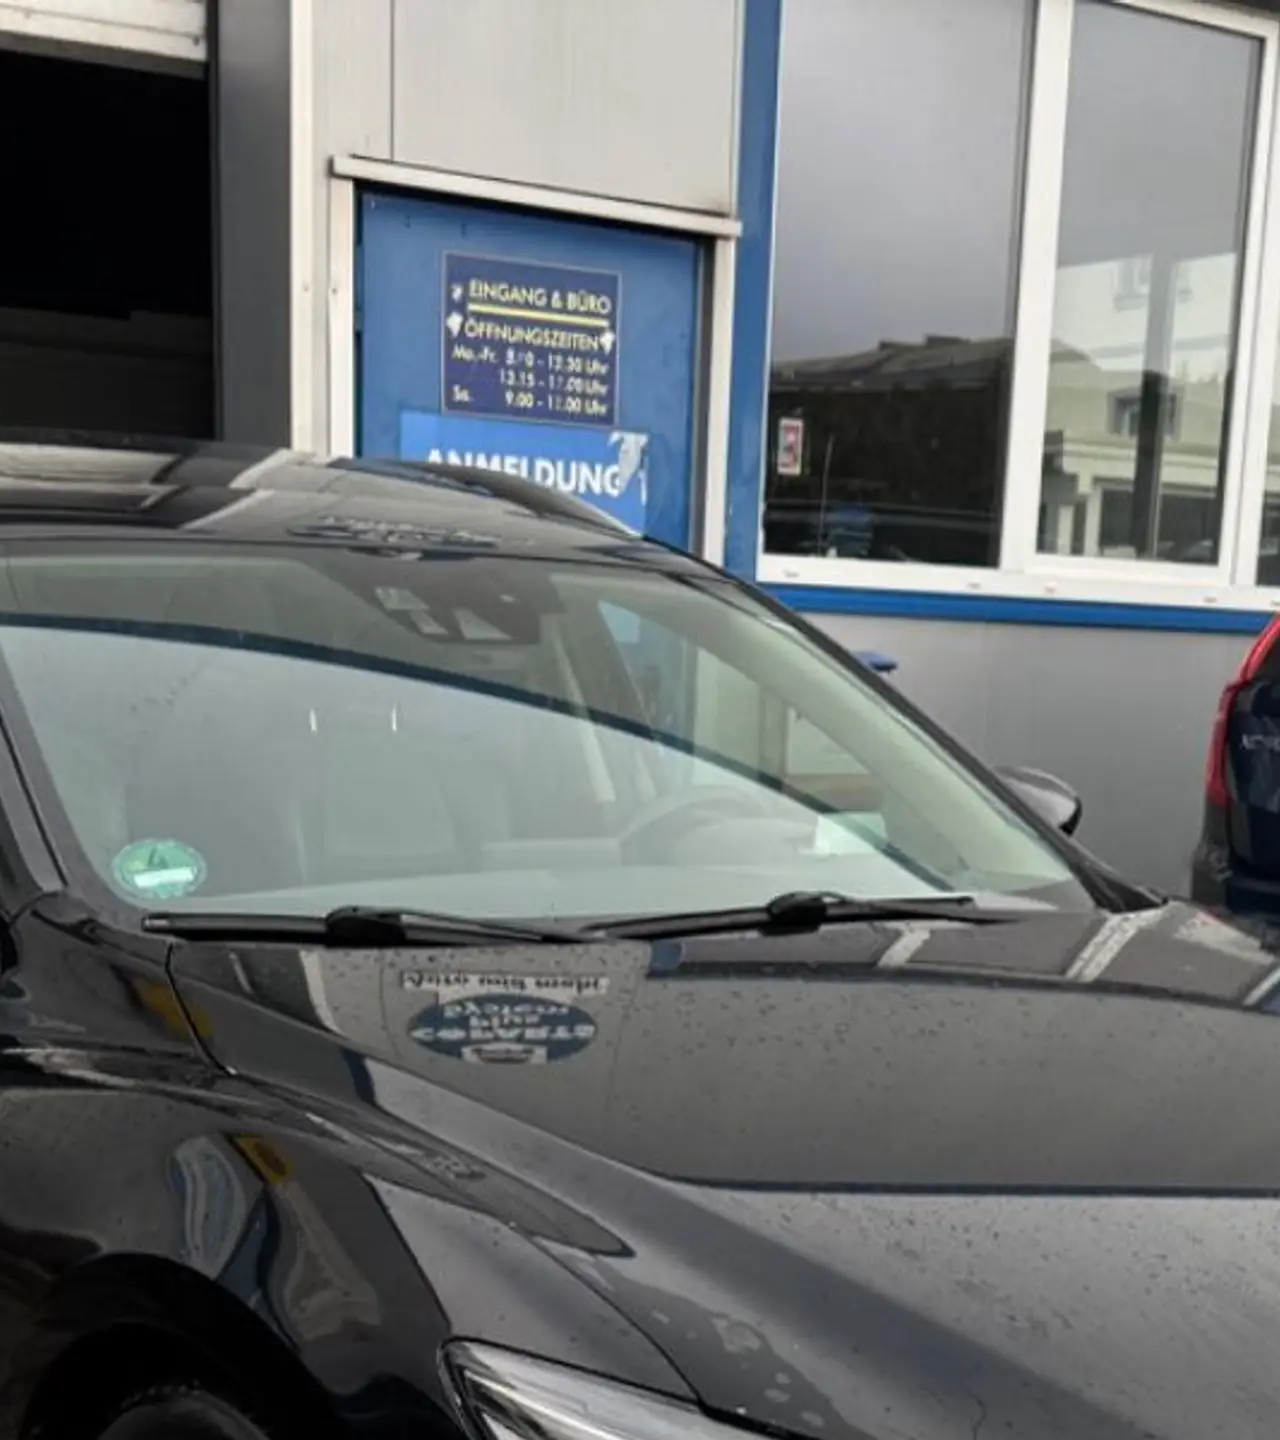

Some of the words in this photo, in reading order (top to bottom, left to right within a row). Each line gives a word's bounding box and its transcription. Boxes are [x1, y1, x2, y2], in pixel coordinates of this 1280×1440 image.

[469, 278, 547, 306] EINGANG
[552, 289, 562, 309] &
[568, 289, 612, 314] BÜRO
[464, 318, 599, 351] ÖFFNUNGSZEITEN
[585, 357, 609, 375] Uhr
[585, 378, 609, 395] Uhr
[585, 398, 608, 416] Uhr
